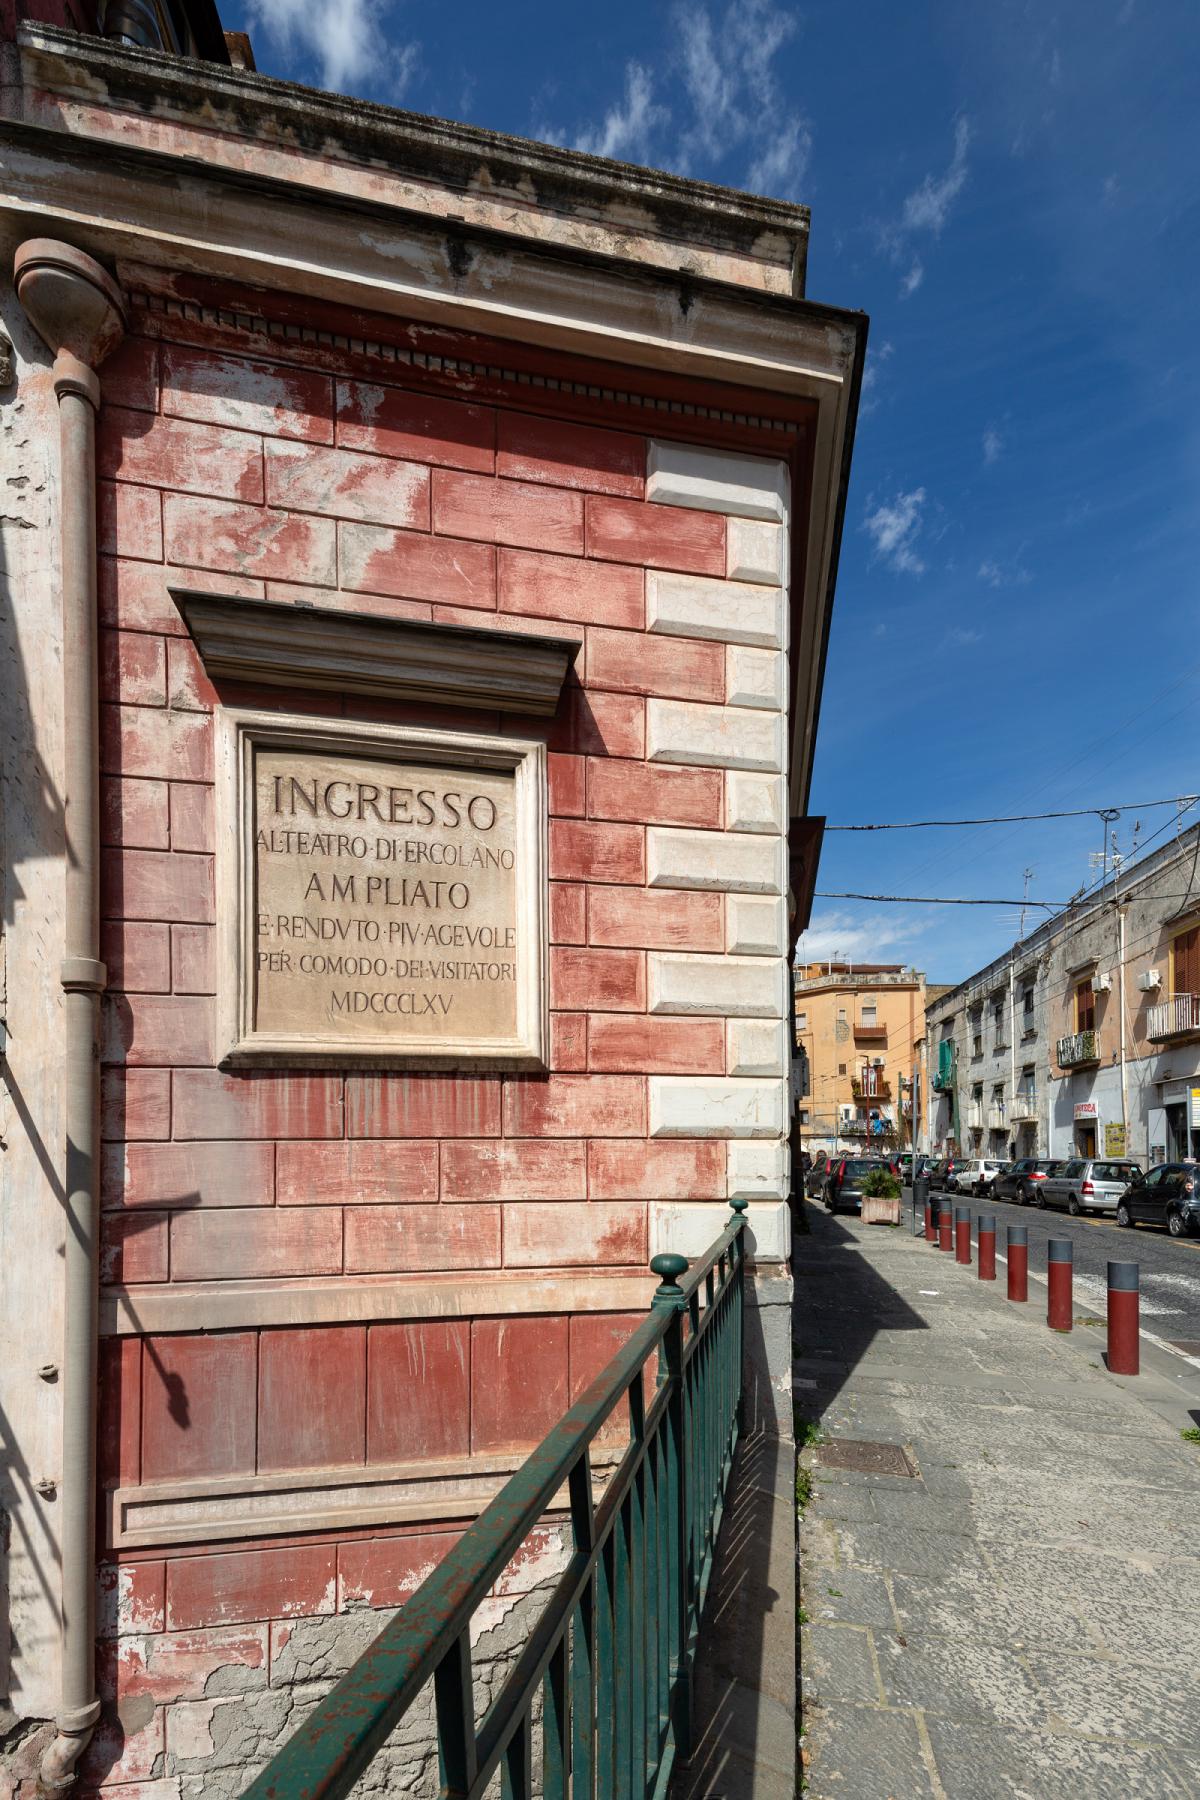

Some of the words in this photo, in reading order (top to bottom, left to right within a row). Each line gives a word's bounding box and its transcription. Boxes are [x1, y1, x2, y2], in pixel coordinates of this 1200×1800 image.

[273, 776, 497, 831] INGRESSO
[256, 830, 283, 853] AL
[281, 831, 367, 859] TEATRO
[376, 838, 396, 861] DI
[405, 841, 515, 870] ERCOLANO
[304, 873, 469, 909] AMPLIATO
[257, 914, 270, 936] E
[277, 915, 379, 942] RENDVTO
[389, 922, 420, 946] PIV
[424, 924, 516, 949] AGEVOLE
[257, 952, 293, 973] PER
[299, 955, 387, 977] COMODO
[396, 959, 423, 979] DEI
[428, 961, 517, 981] VISITATORI
[331, 991, 454, 1015] MDCCCLXV
